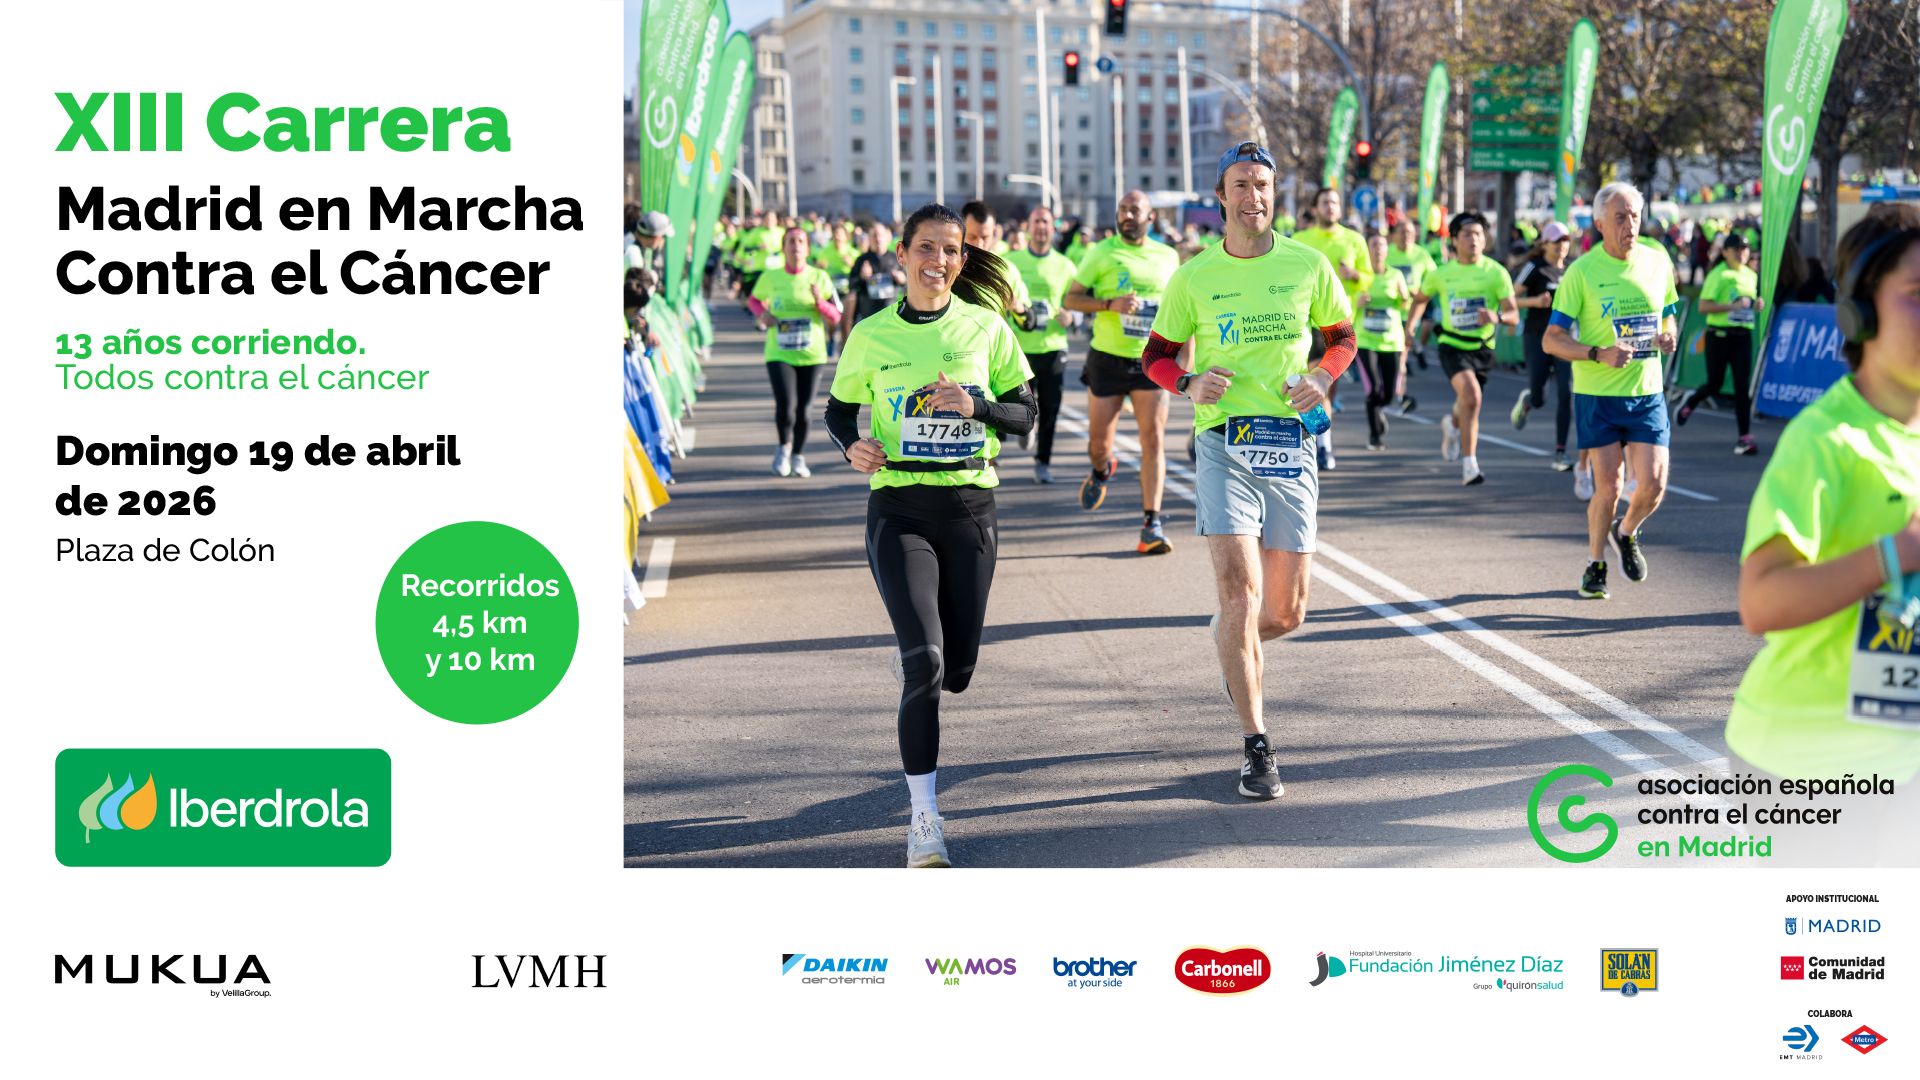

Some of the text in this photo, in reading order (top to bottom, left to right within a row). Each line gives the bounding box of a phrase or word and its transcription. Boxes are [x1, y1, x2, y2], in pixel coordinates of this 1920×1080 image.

[1786, 27, 1810, 92] asociación
[684, 15, 720, 138] Iberdrola
[1796, 57, 1814, 103] contra
[1807, 45, 1830, 113] en Madrid
[1242, 313, 1296, 324] MADRID EN
[1243, 323, 1286, 334] MARCHA
[1218, 319, 1239, 346] XII
[1245, 335, 1273, 343] CONTRA
[917, 422, 971, 439] 17748
